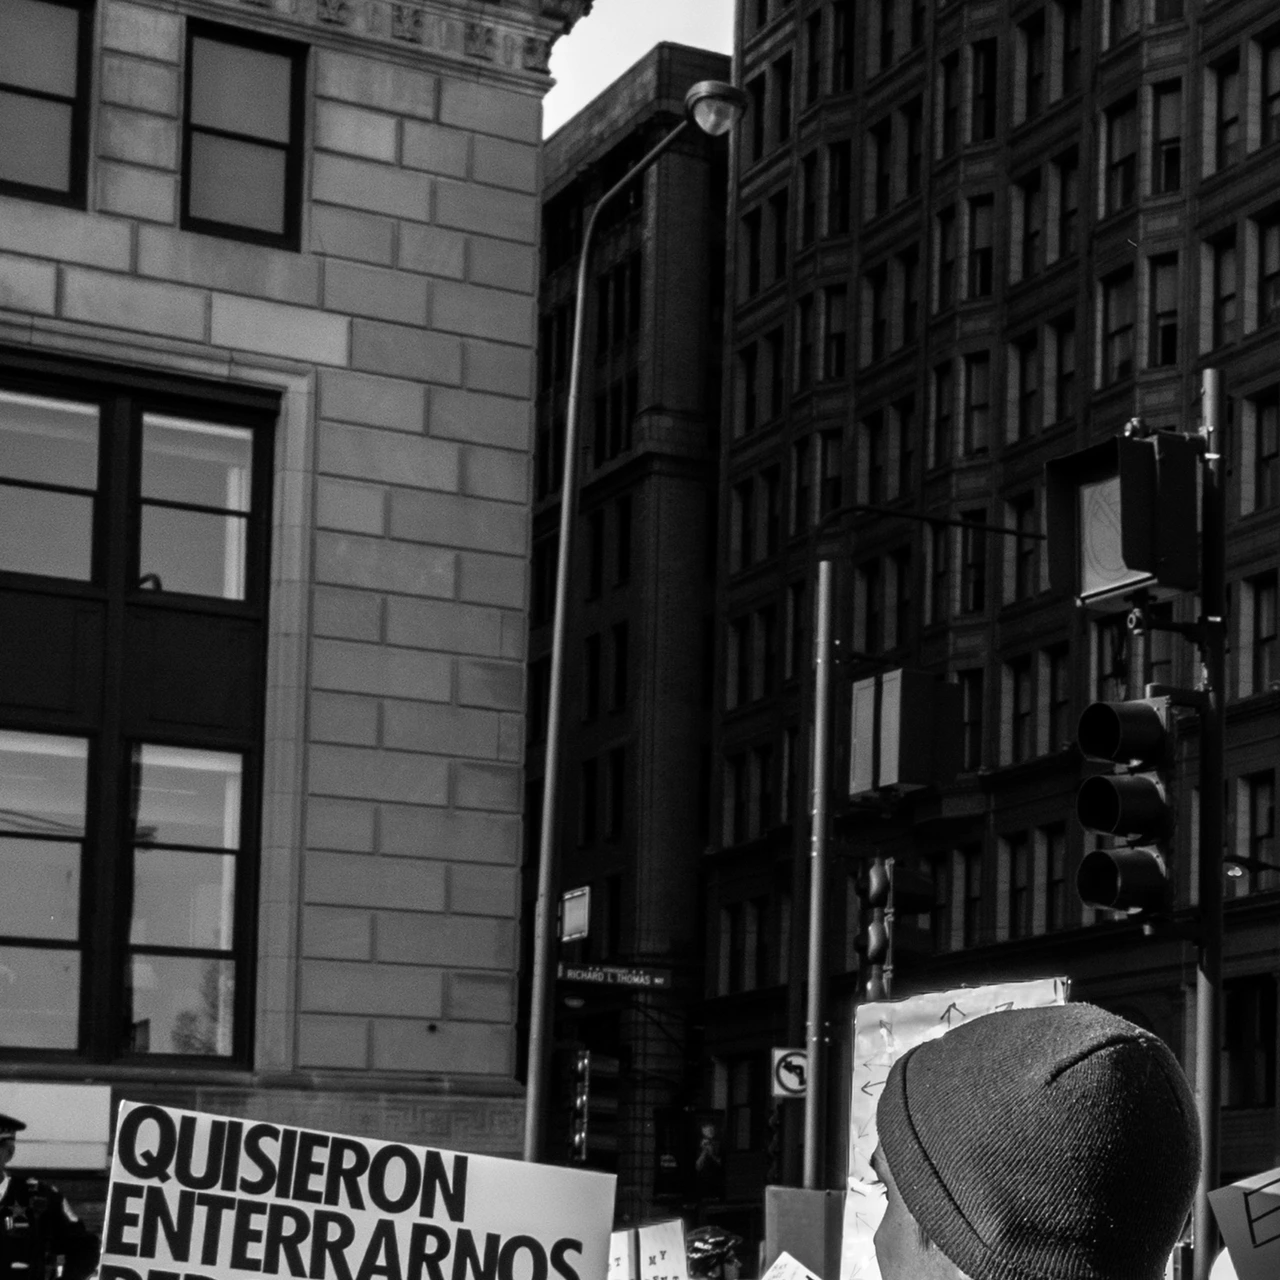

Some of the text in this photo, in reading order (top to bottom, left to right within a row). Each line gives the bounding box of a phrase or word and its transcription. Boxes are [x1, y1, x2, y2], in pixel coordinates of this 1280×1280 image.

[566, 969, 605, 982] RICHARD
[617, 972, 651, 986] THOMAS
[116, 1103, 470, 1224] QUISIERON
[648, 1249, 667, 1267] MY
